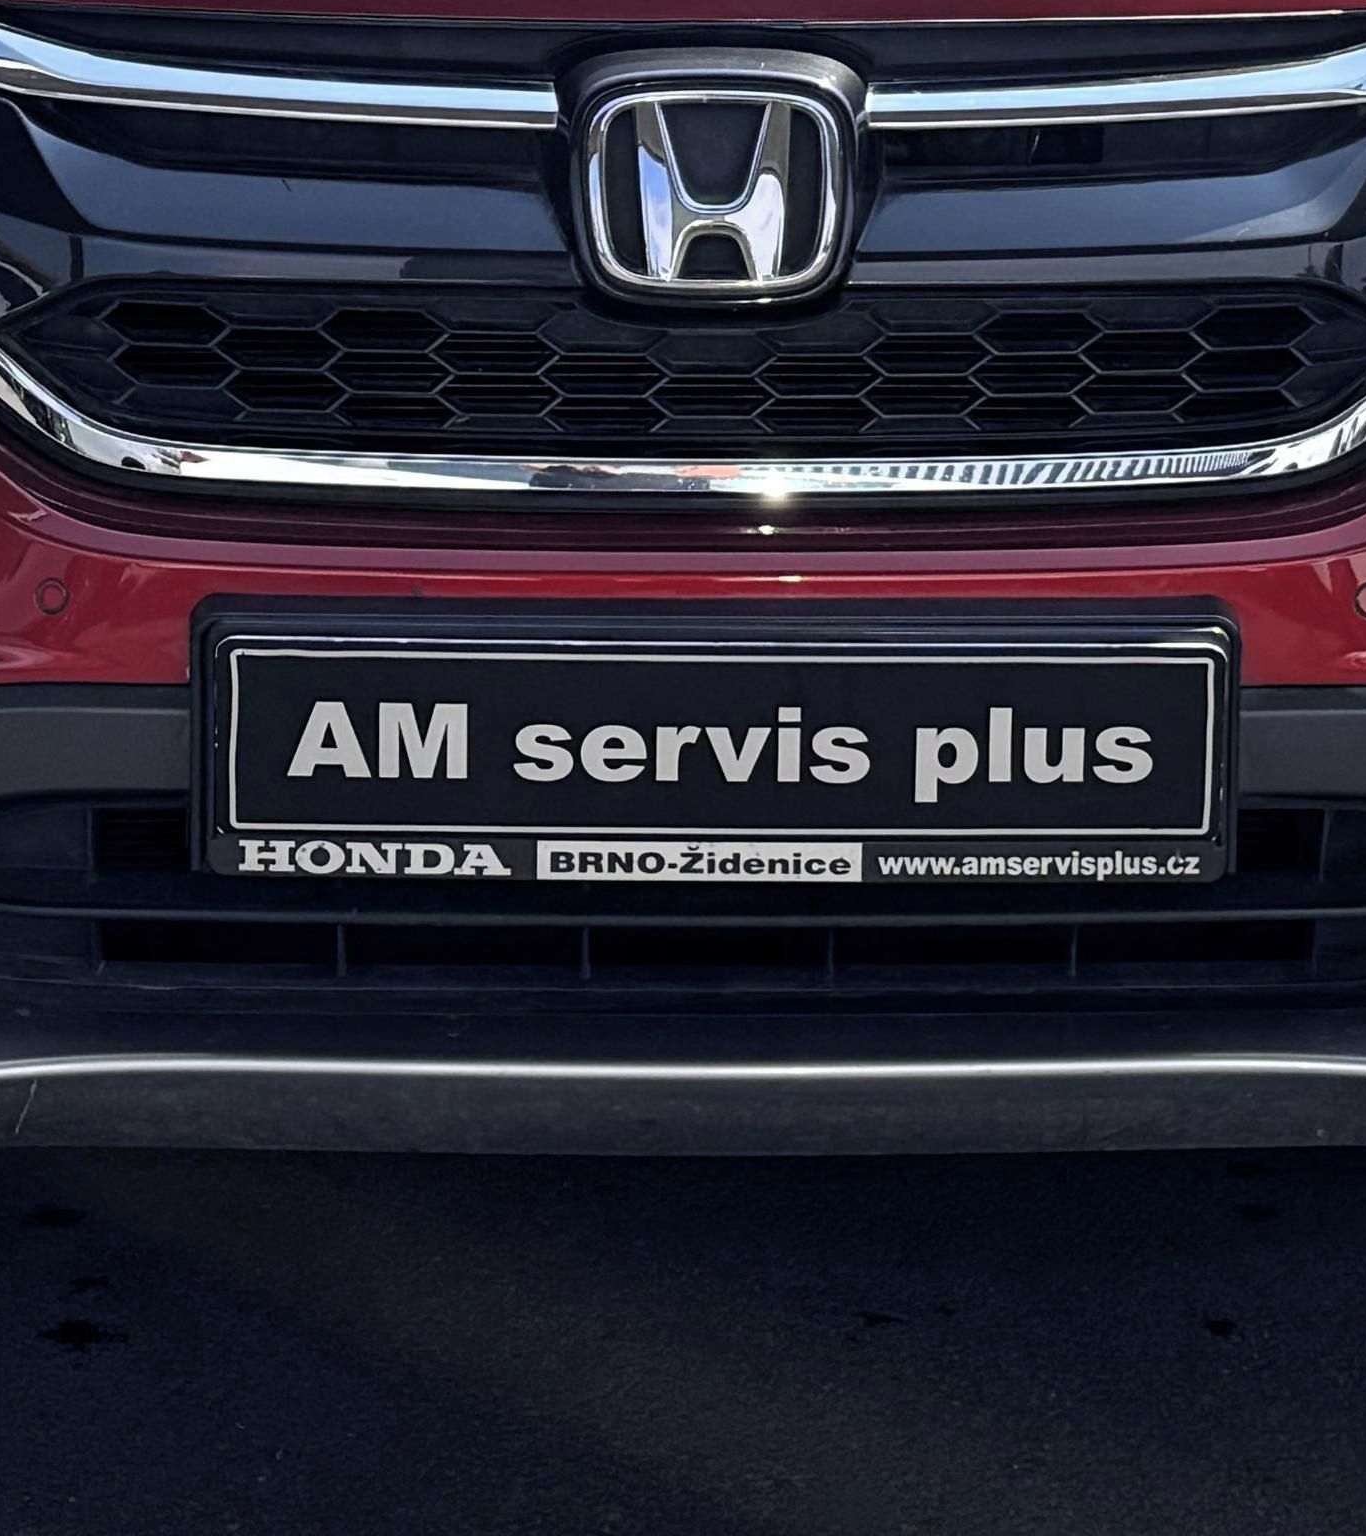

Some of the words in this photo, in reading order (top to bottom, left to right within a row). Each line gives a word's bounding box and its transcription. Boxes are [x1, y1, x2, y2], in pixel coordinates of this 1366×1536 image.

[287, 701, 469, 780] AM
[512, 706, 872, 785] servis
[914, 707, 1154, 803] plus
[238, 839, 512, 876] HONDA
[549, 842, 852, 875] BRNO-Židenice
[878, 850, 1200, 882] www.amservisplus.cz
